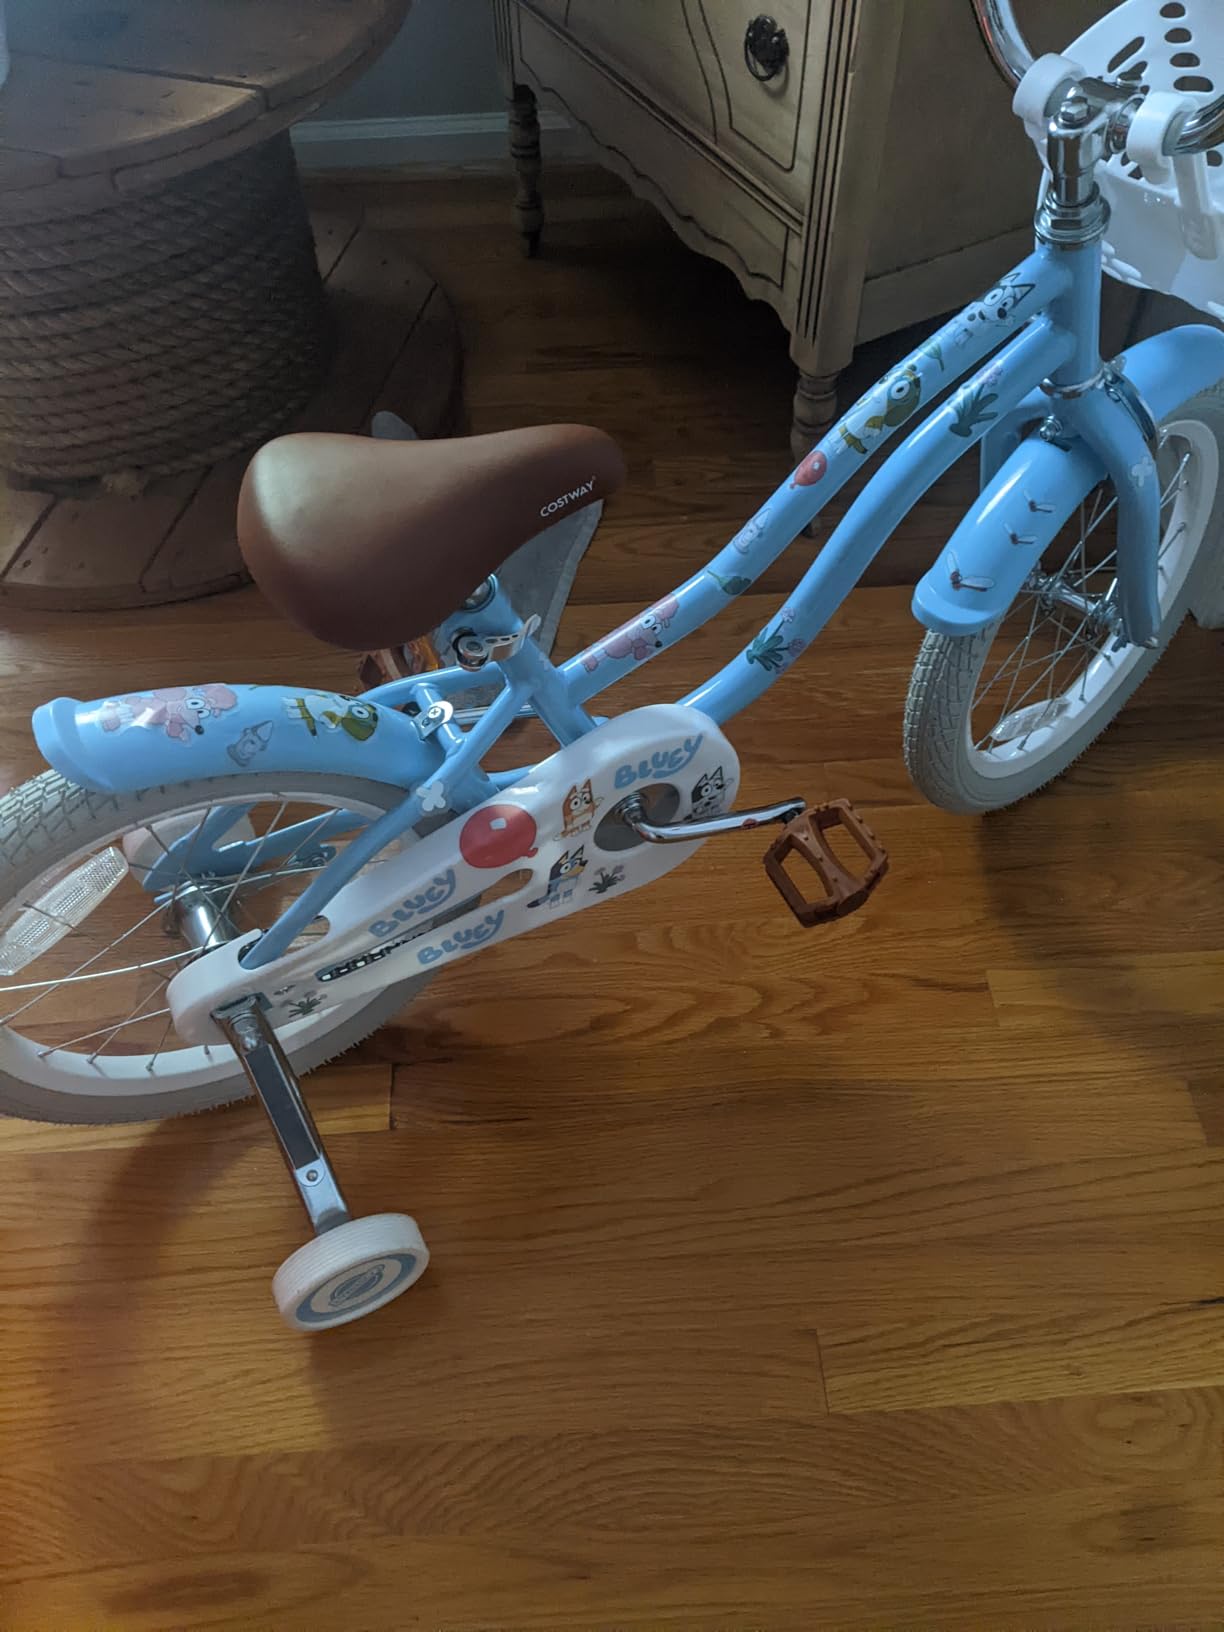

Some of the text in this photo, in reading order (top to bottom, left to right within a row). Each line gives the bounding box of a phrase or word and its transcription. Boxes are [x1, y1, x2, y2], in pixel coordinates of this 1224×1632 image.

[540, 480, 594, 517] COSTWAY
[614, 732, 704, 789] BLUEY
[368, 868, 456, 938] BLUEY
[417, 909, 505, 965] BLUEY
